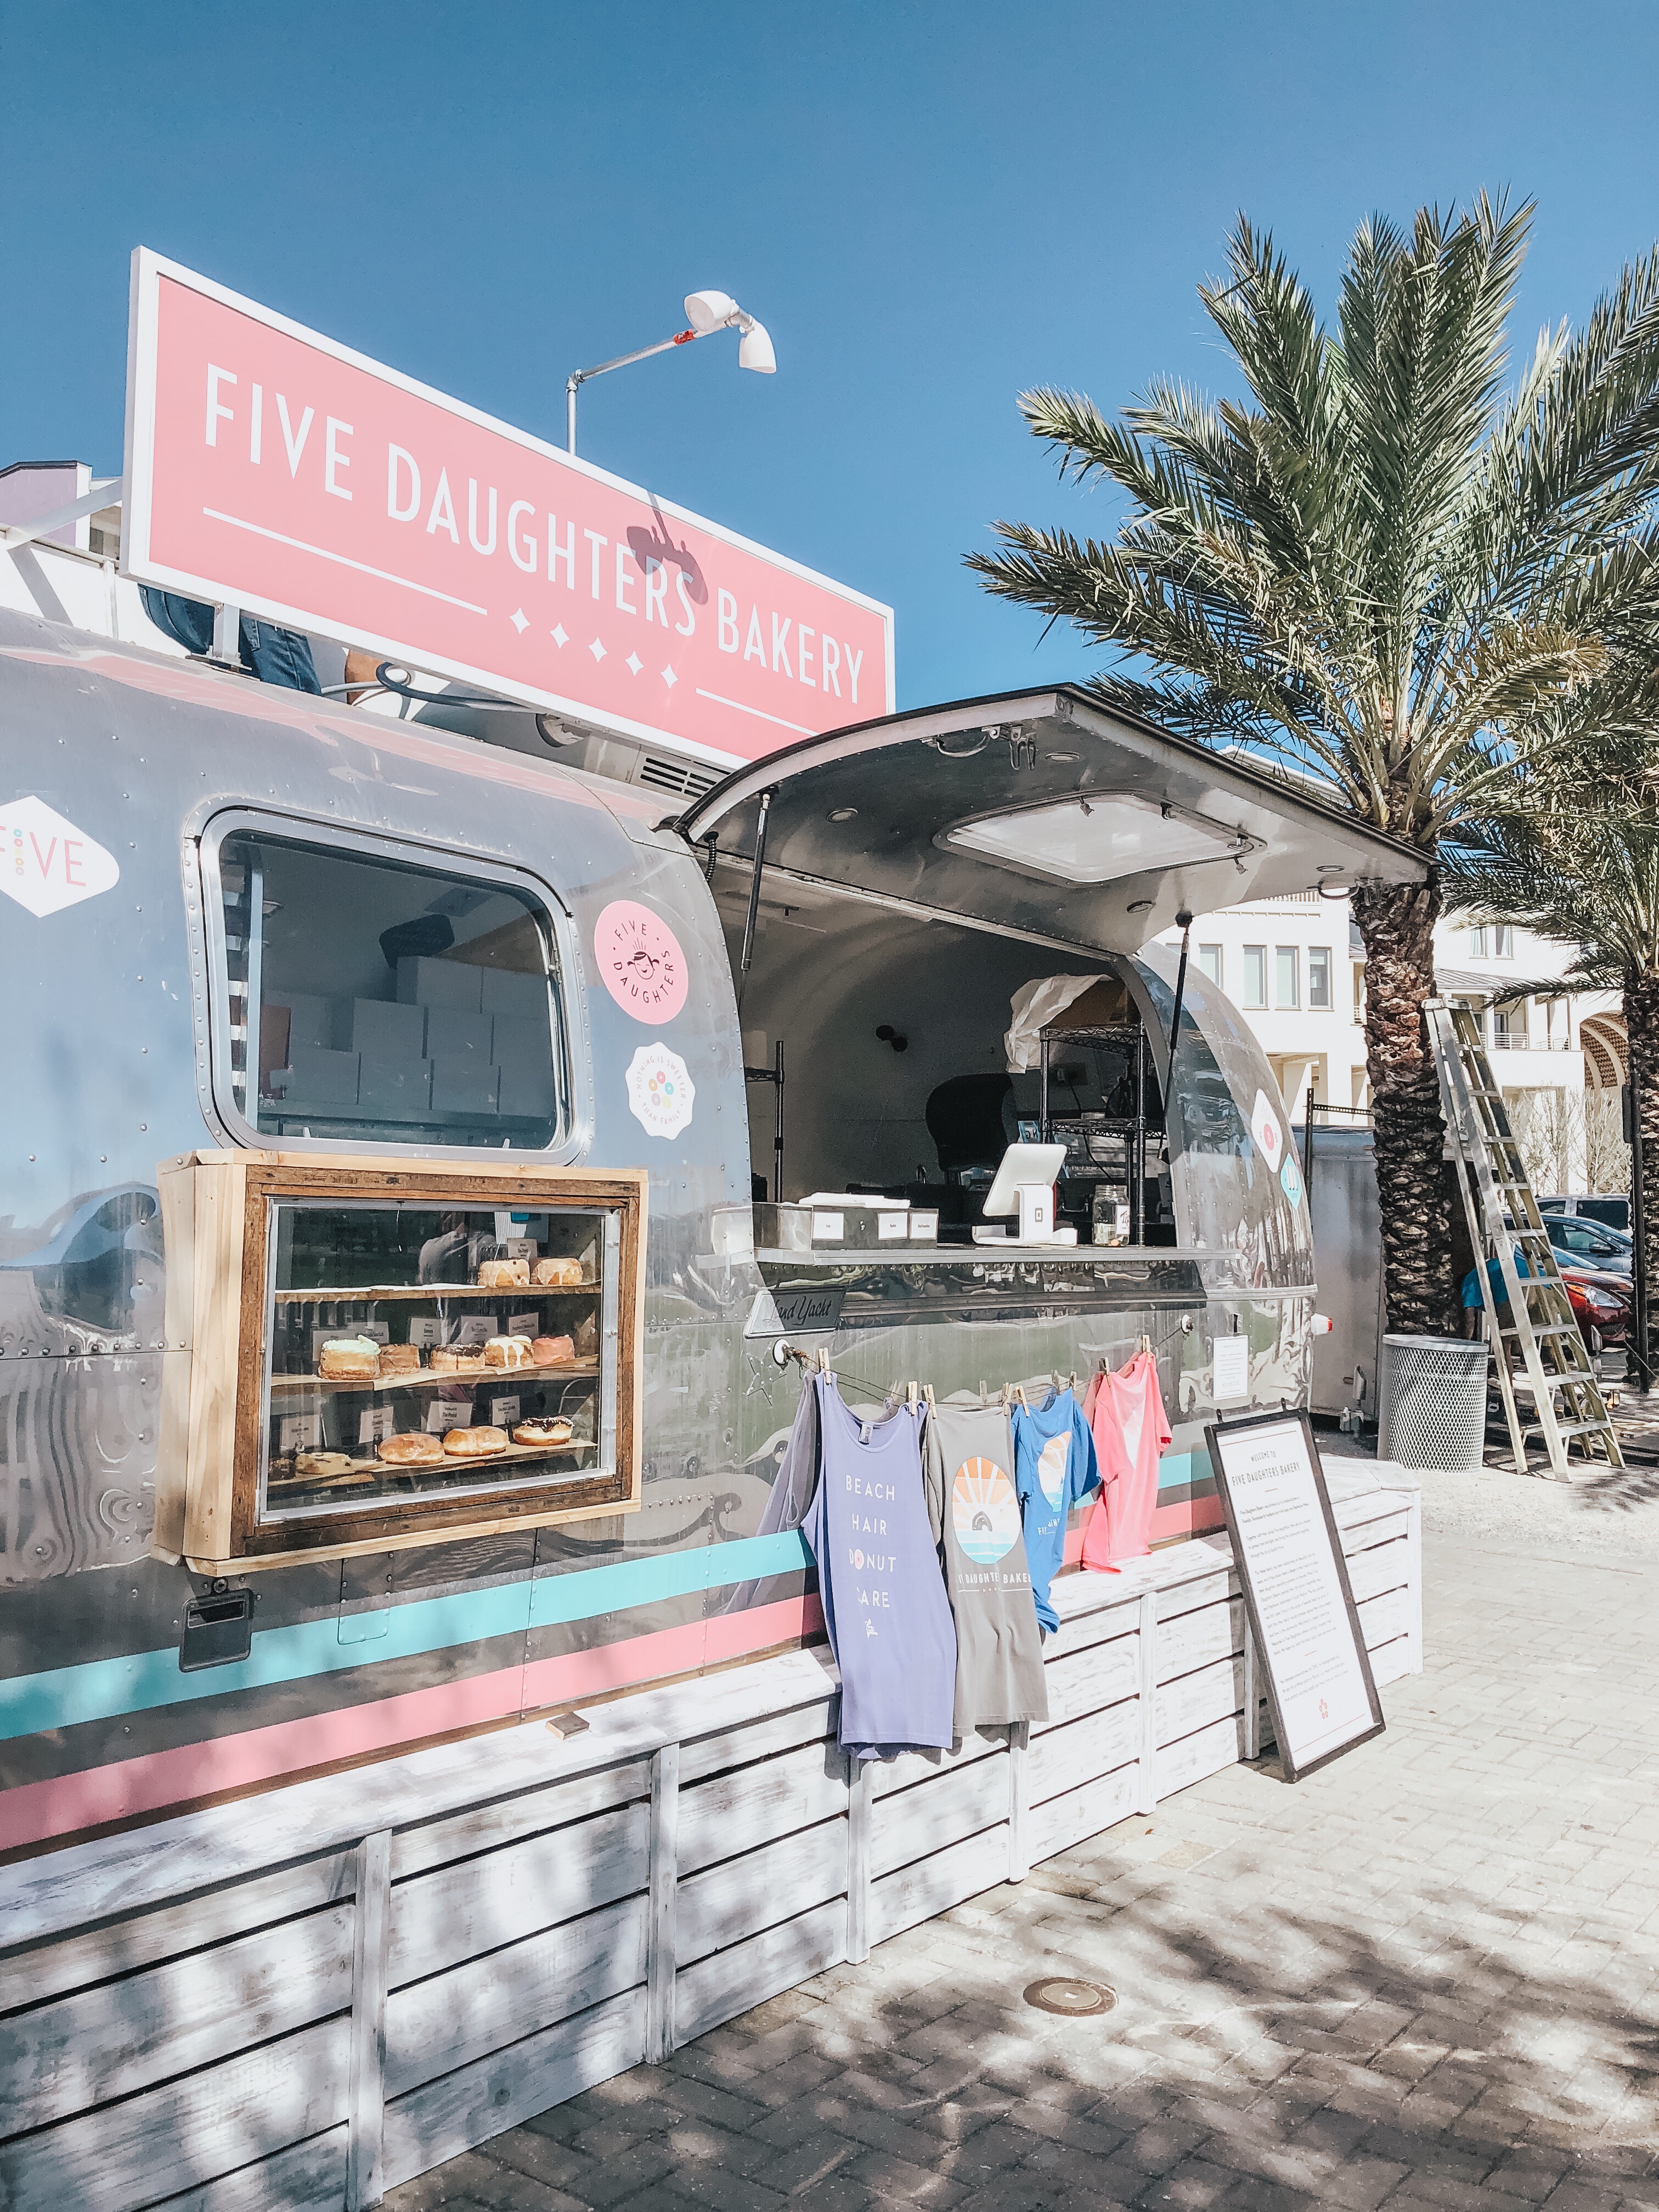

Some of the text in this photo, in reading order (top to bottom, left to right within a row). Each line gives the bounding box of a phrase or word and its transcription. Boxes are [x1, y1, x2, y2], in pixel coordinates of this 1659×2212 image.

[205, 363, 864, 704] FIVE DAUGHTERS BAKERY
[614, 921, 646, 941] FIVE
[613, 951, 674, 1003] DAUGHTERS
[636, 1056, 654, 1089] NOTHING
[667, 1060, 685, 1098] SWEETER
[641, 1102, 681, 1125] THAN FAMILY
[793, 1296, 832, 1325] Yacht
[1251, 1451, 1269, 1462] WELCOME
[1232, 1462, 1300, 1486] FIVE DAUGHTERS BAKERY
[845, 1474, 895, 1501] BEACH
[851, 1513, 887, 1536] HAIR
[848, 1548, 896, 1573] DONUT
[965, 1572, 999, 1584] DAUGHTE
[1003, 1572, 1031, 1584] BAKE
